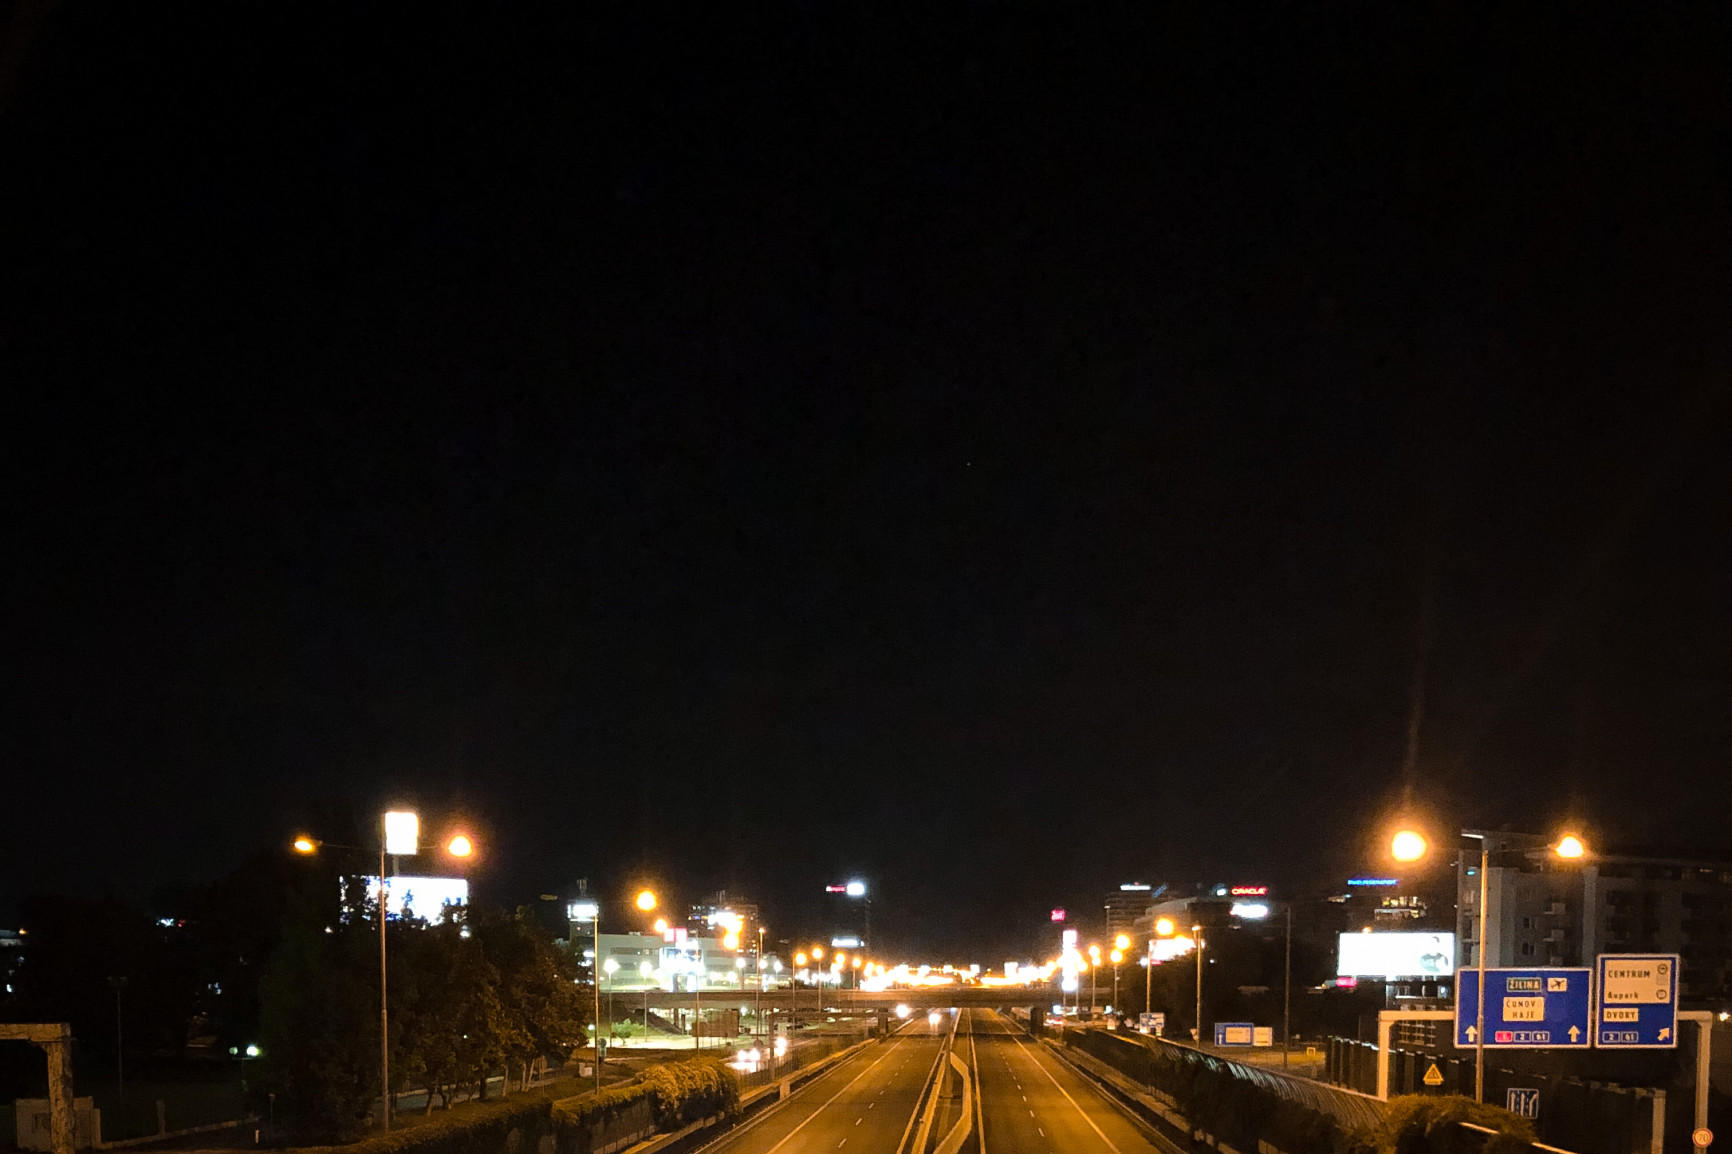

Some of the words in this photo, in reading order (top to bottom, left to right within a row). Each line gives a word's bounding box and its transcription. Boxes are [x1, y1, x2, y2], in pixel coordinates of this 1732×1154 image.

[1231, 887, 1267, 895] ORACLE
[1608, 970, 1651, 978] CENTRUM
[1509, 979, 1539, 989] ŽILINA
[1608, 991, 1639, 1000] Aupark
[1606, 1011, 1636, 1019] DVORY
[1699, 1133, 1708, 1142] 70
